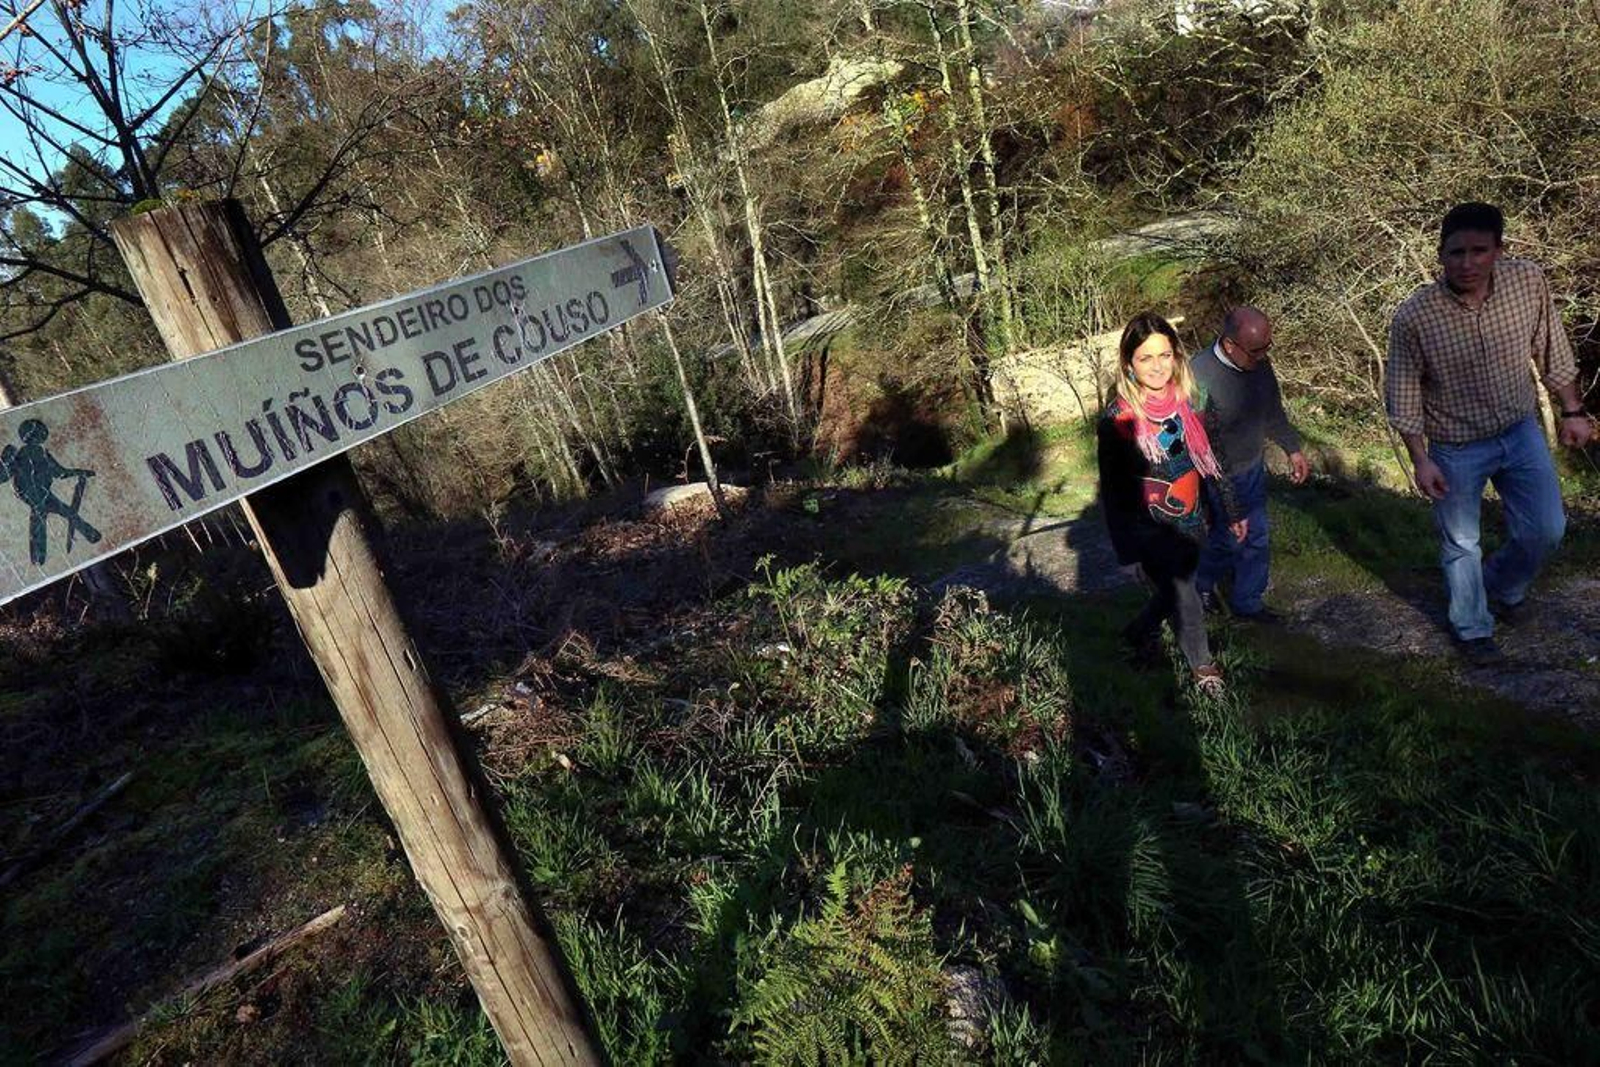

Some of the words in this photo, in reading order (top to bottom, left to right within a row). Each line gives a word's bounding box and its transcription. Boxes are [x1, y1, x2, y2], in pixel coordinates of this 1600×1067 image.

[146, 367, 414, 511] MUÍÑOS
[421, 337, 488, 397] DE
[492, 291, 610, 365] COUSO
[295, 293, 469, 372] SENDEIRO
[475, 275, 527, 314] DOS
